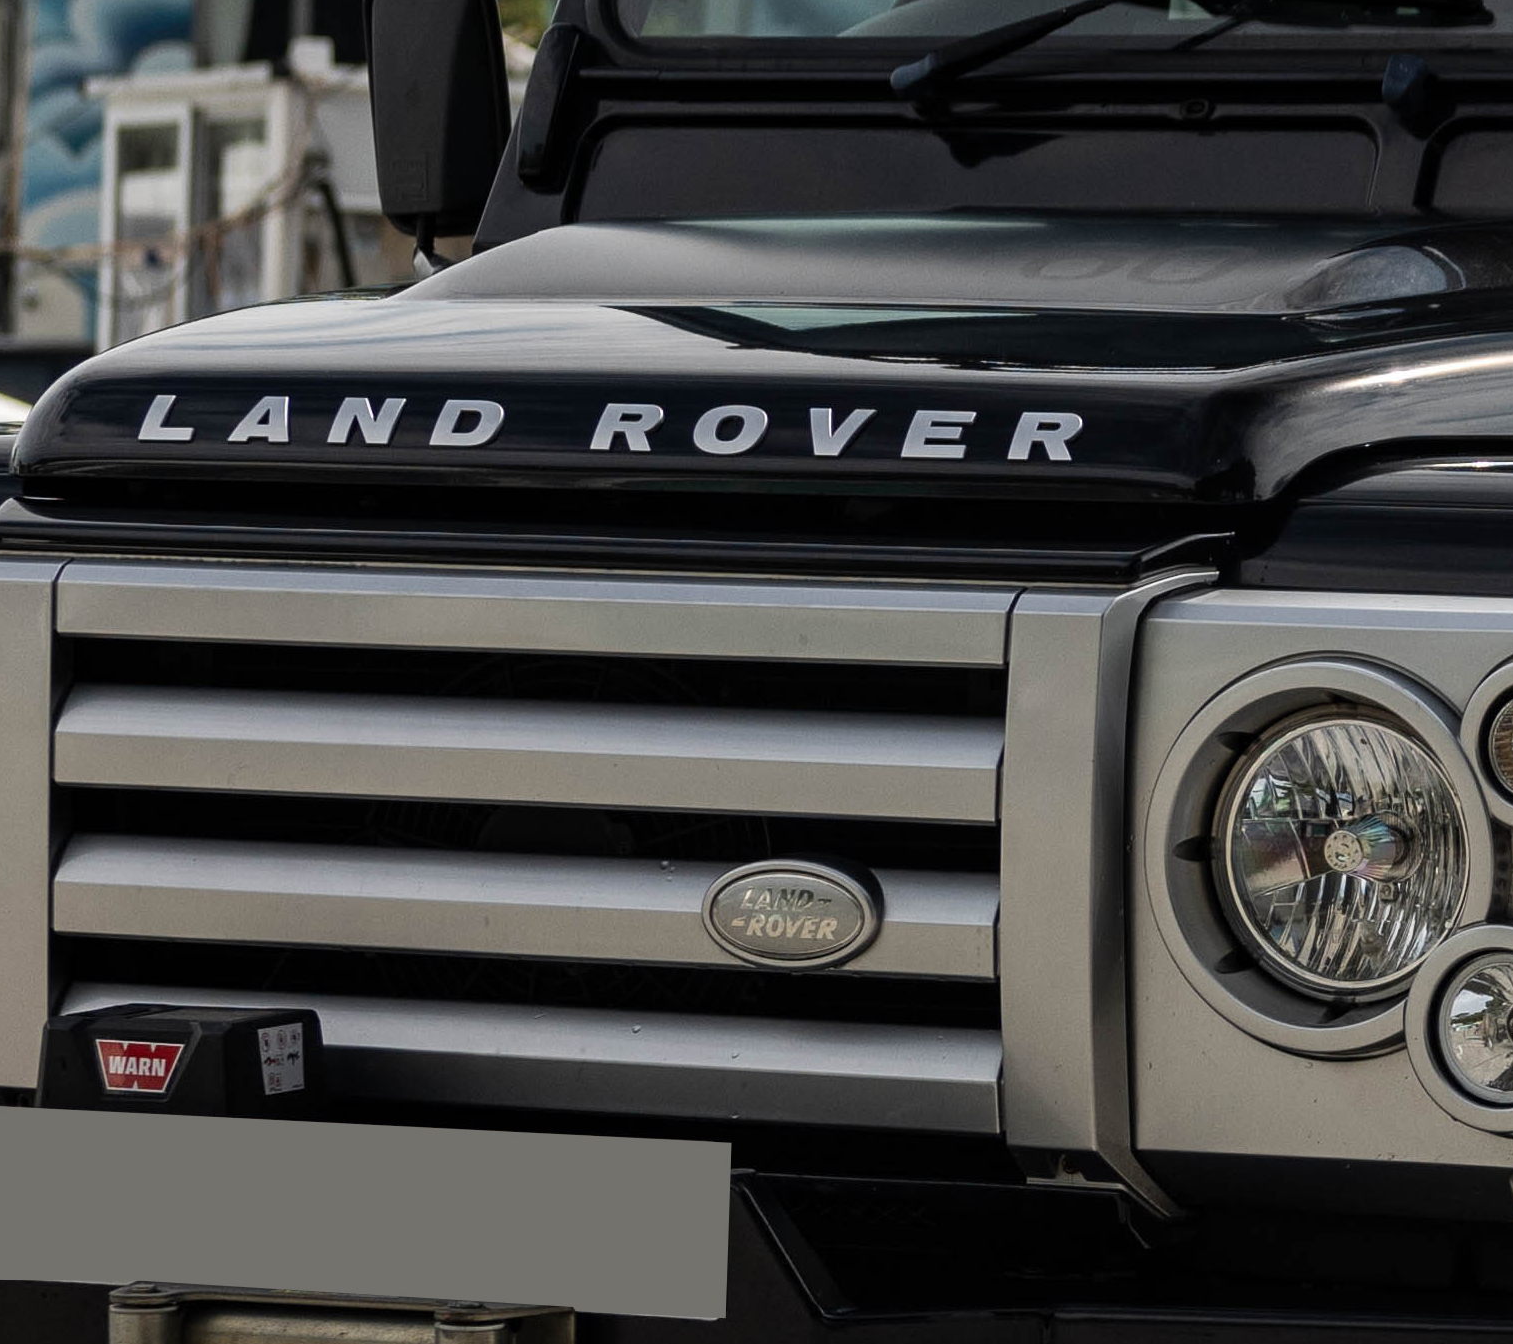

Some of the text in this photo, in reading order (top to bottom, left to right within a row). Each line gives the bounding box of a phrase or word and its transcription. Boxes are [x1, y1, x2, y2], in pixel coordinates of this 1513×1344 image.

[137, 393, 1085, 461] LAND ROVER
[745, 912, 837, 941] ROVER
[107, 1055, 167, 1077] WARN
